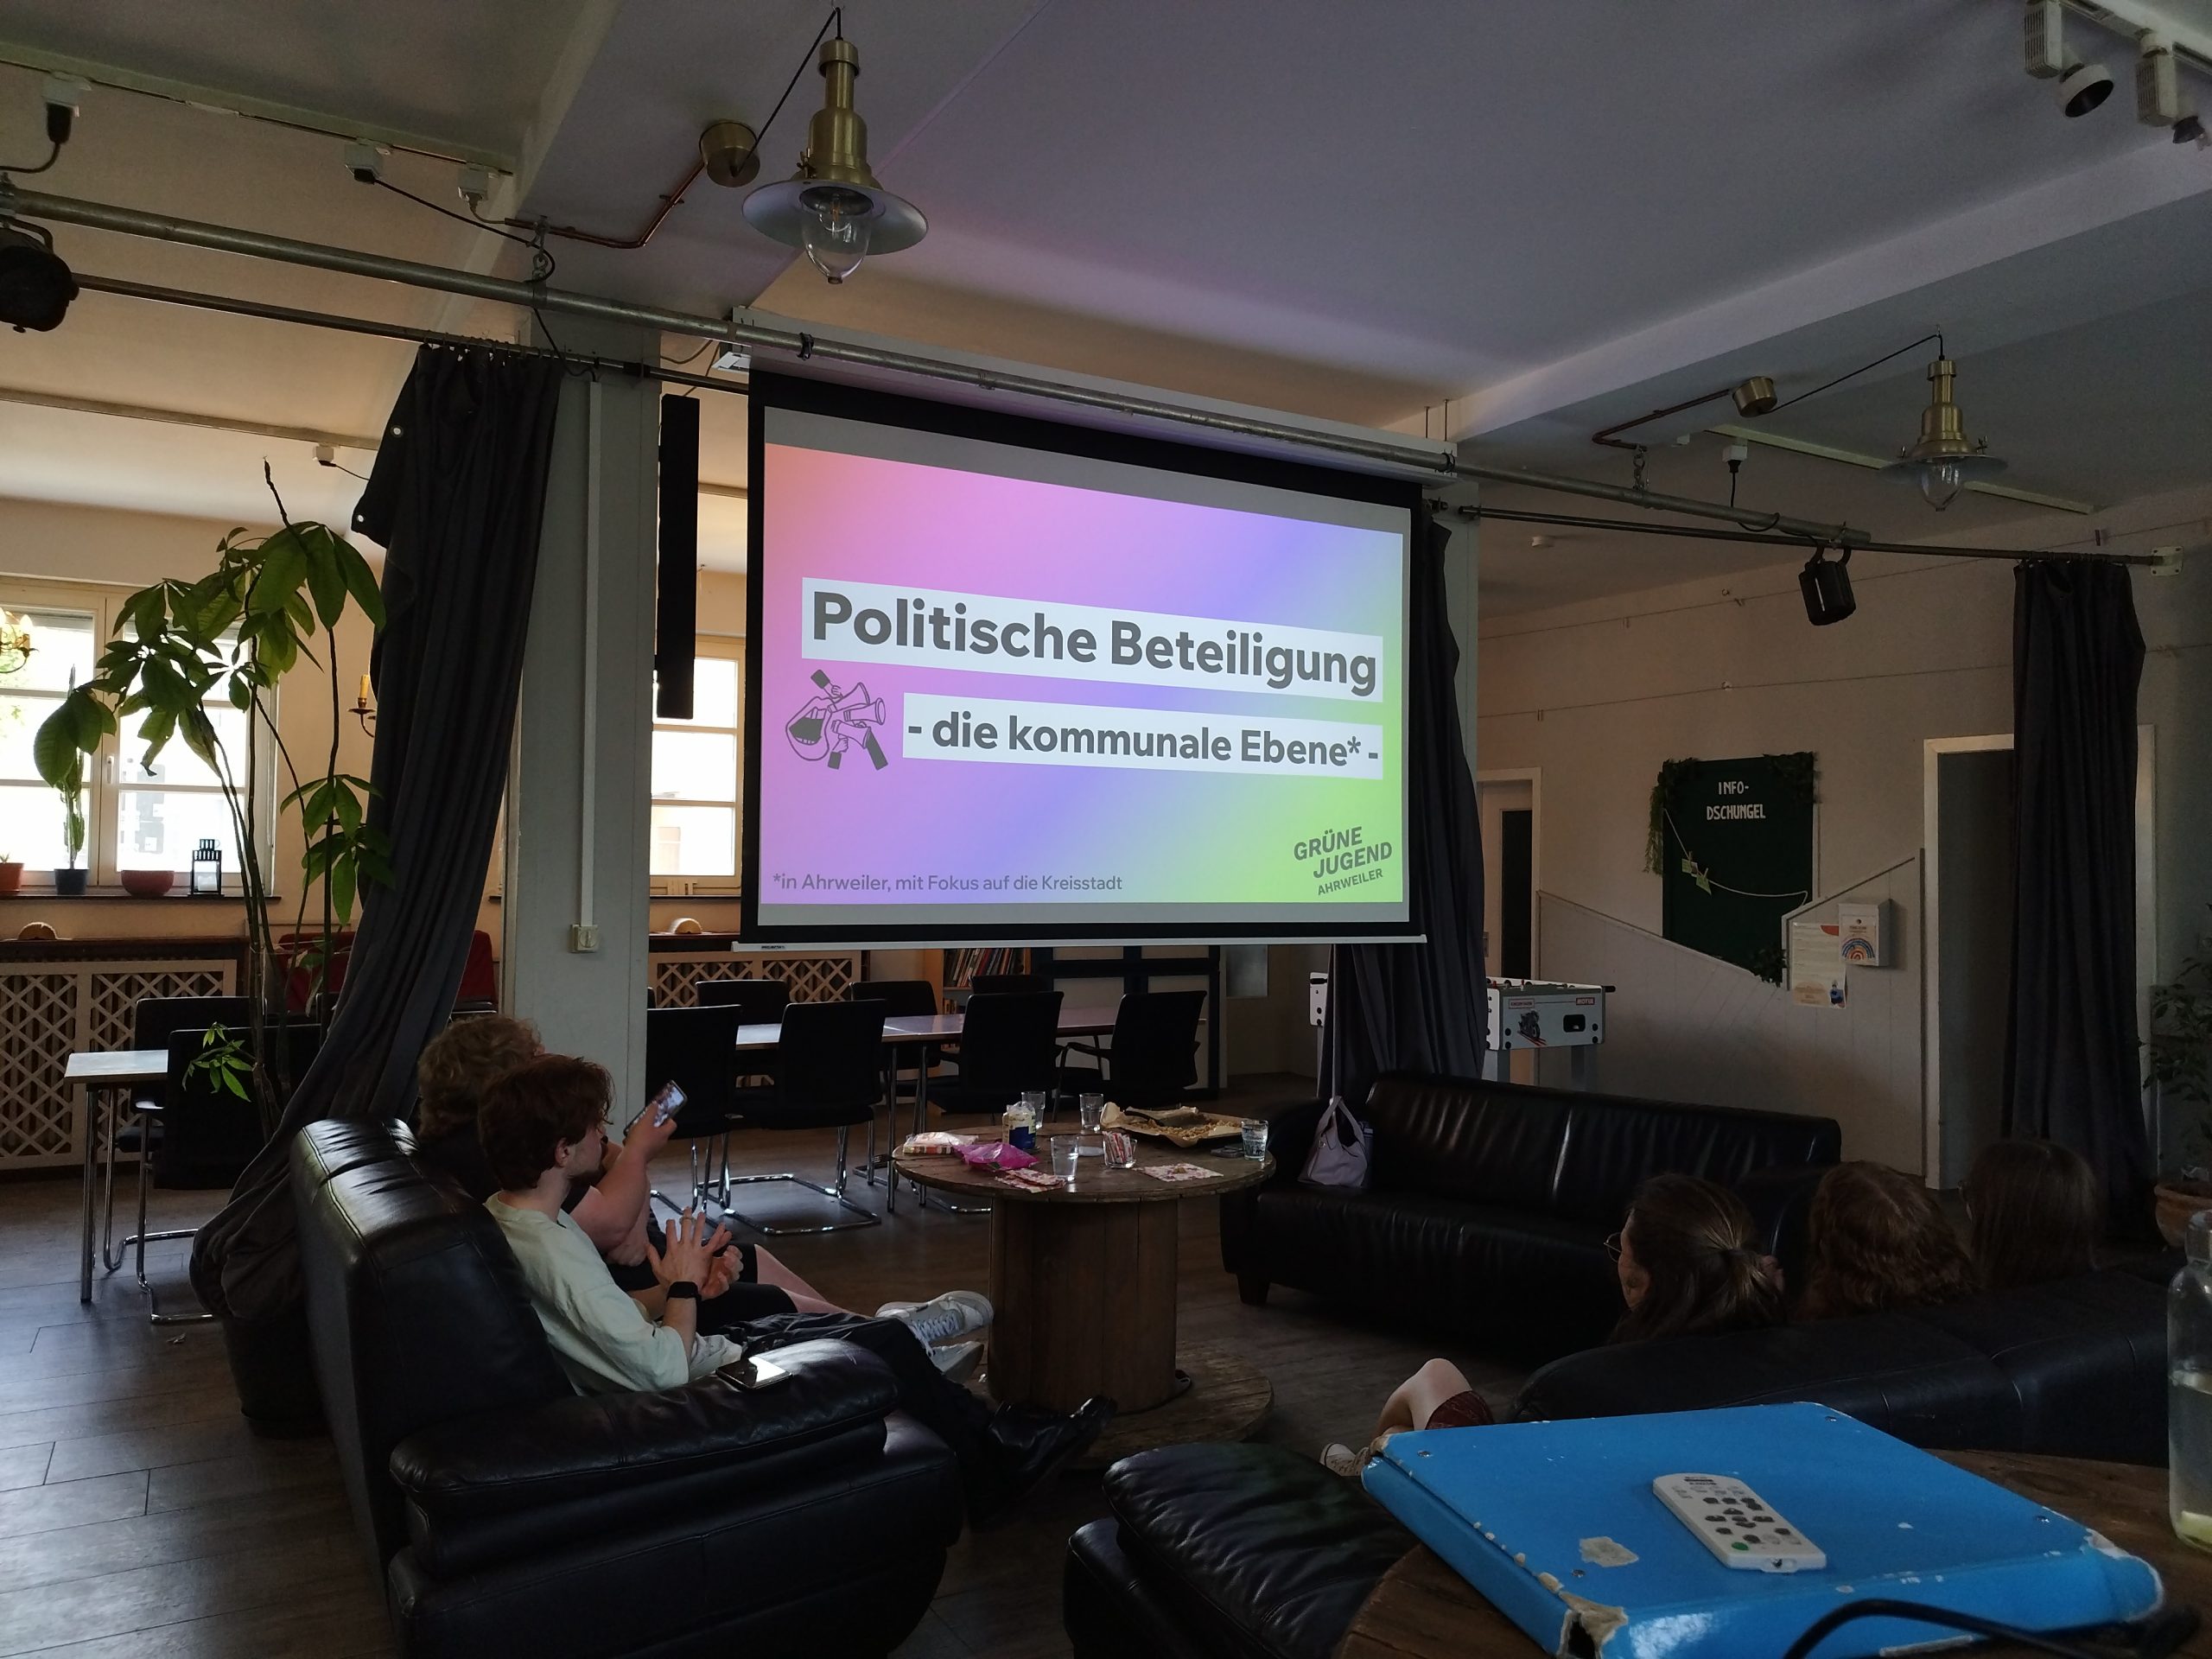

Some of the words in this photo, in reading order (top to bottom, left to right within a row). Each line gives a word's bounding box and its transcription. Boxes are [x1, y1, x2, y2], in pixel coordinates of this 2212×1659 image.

[813, 591, 1096, 663] Politische
[1111, 620, 1376, 696] Beteiligung
[932, 711, 998, 749] die
[1009, 715, 1232, 761] kommunale
[1718, 781, 1749, 795] INFO-
[1707, 804, 1766, 820] DSCHUNGEL
[1294, 826, 1363, 861] GRÜNE
[1313, 842, 1392, 879] JUGEND
[802, 874, 891, 893] Ahrweiler,
[895, 874, 925, 891] mit
[928, 874, 980, 891] Fokus
[983, 874, 1010, 891] auf
[1014, 874, 1039, 891] die
[1042, 874, 1123, 891] Kreisstadt
[1318, 868, 1383, 895] AHRWEILER
